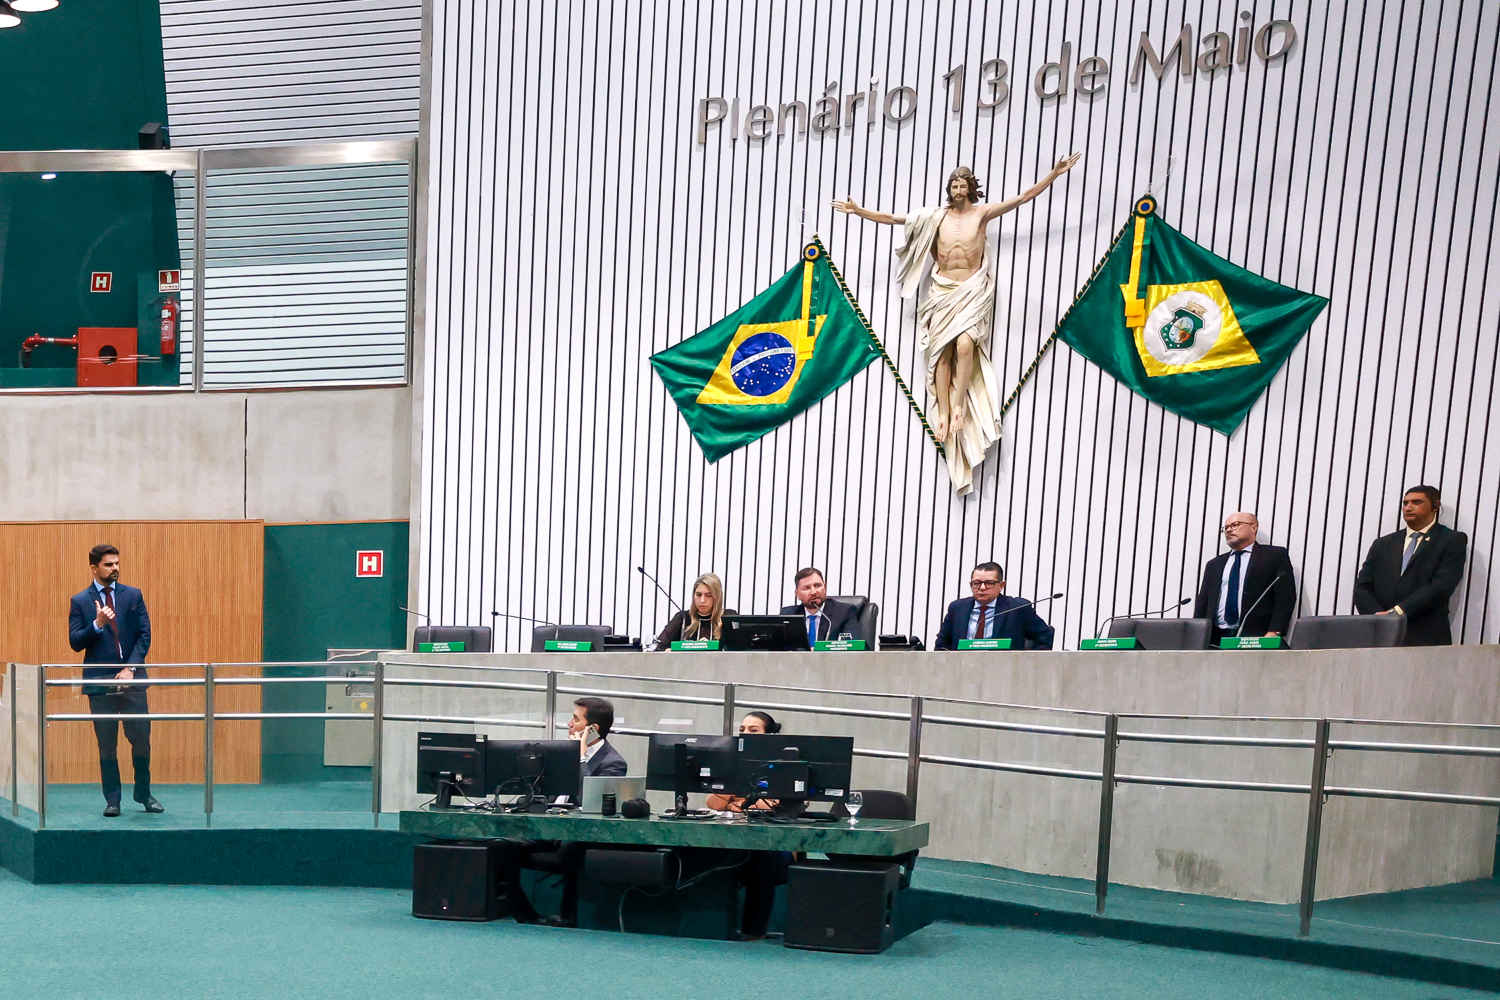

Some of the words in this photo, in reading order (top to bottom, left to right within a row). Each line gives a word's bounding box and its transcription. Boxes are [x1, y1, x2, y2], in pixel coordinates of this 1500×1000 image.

[697, 76, 918, 145] Plenário
[942, 58, 1009, 113] 13
[1034, 41, 1108, 101] de
[1129, 10, 1298, 85] Maio
[95, 276, 107, 289] H
[362, 556, 377, 571] H
